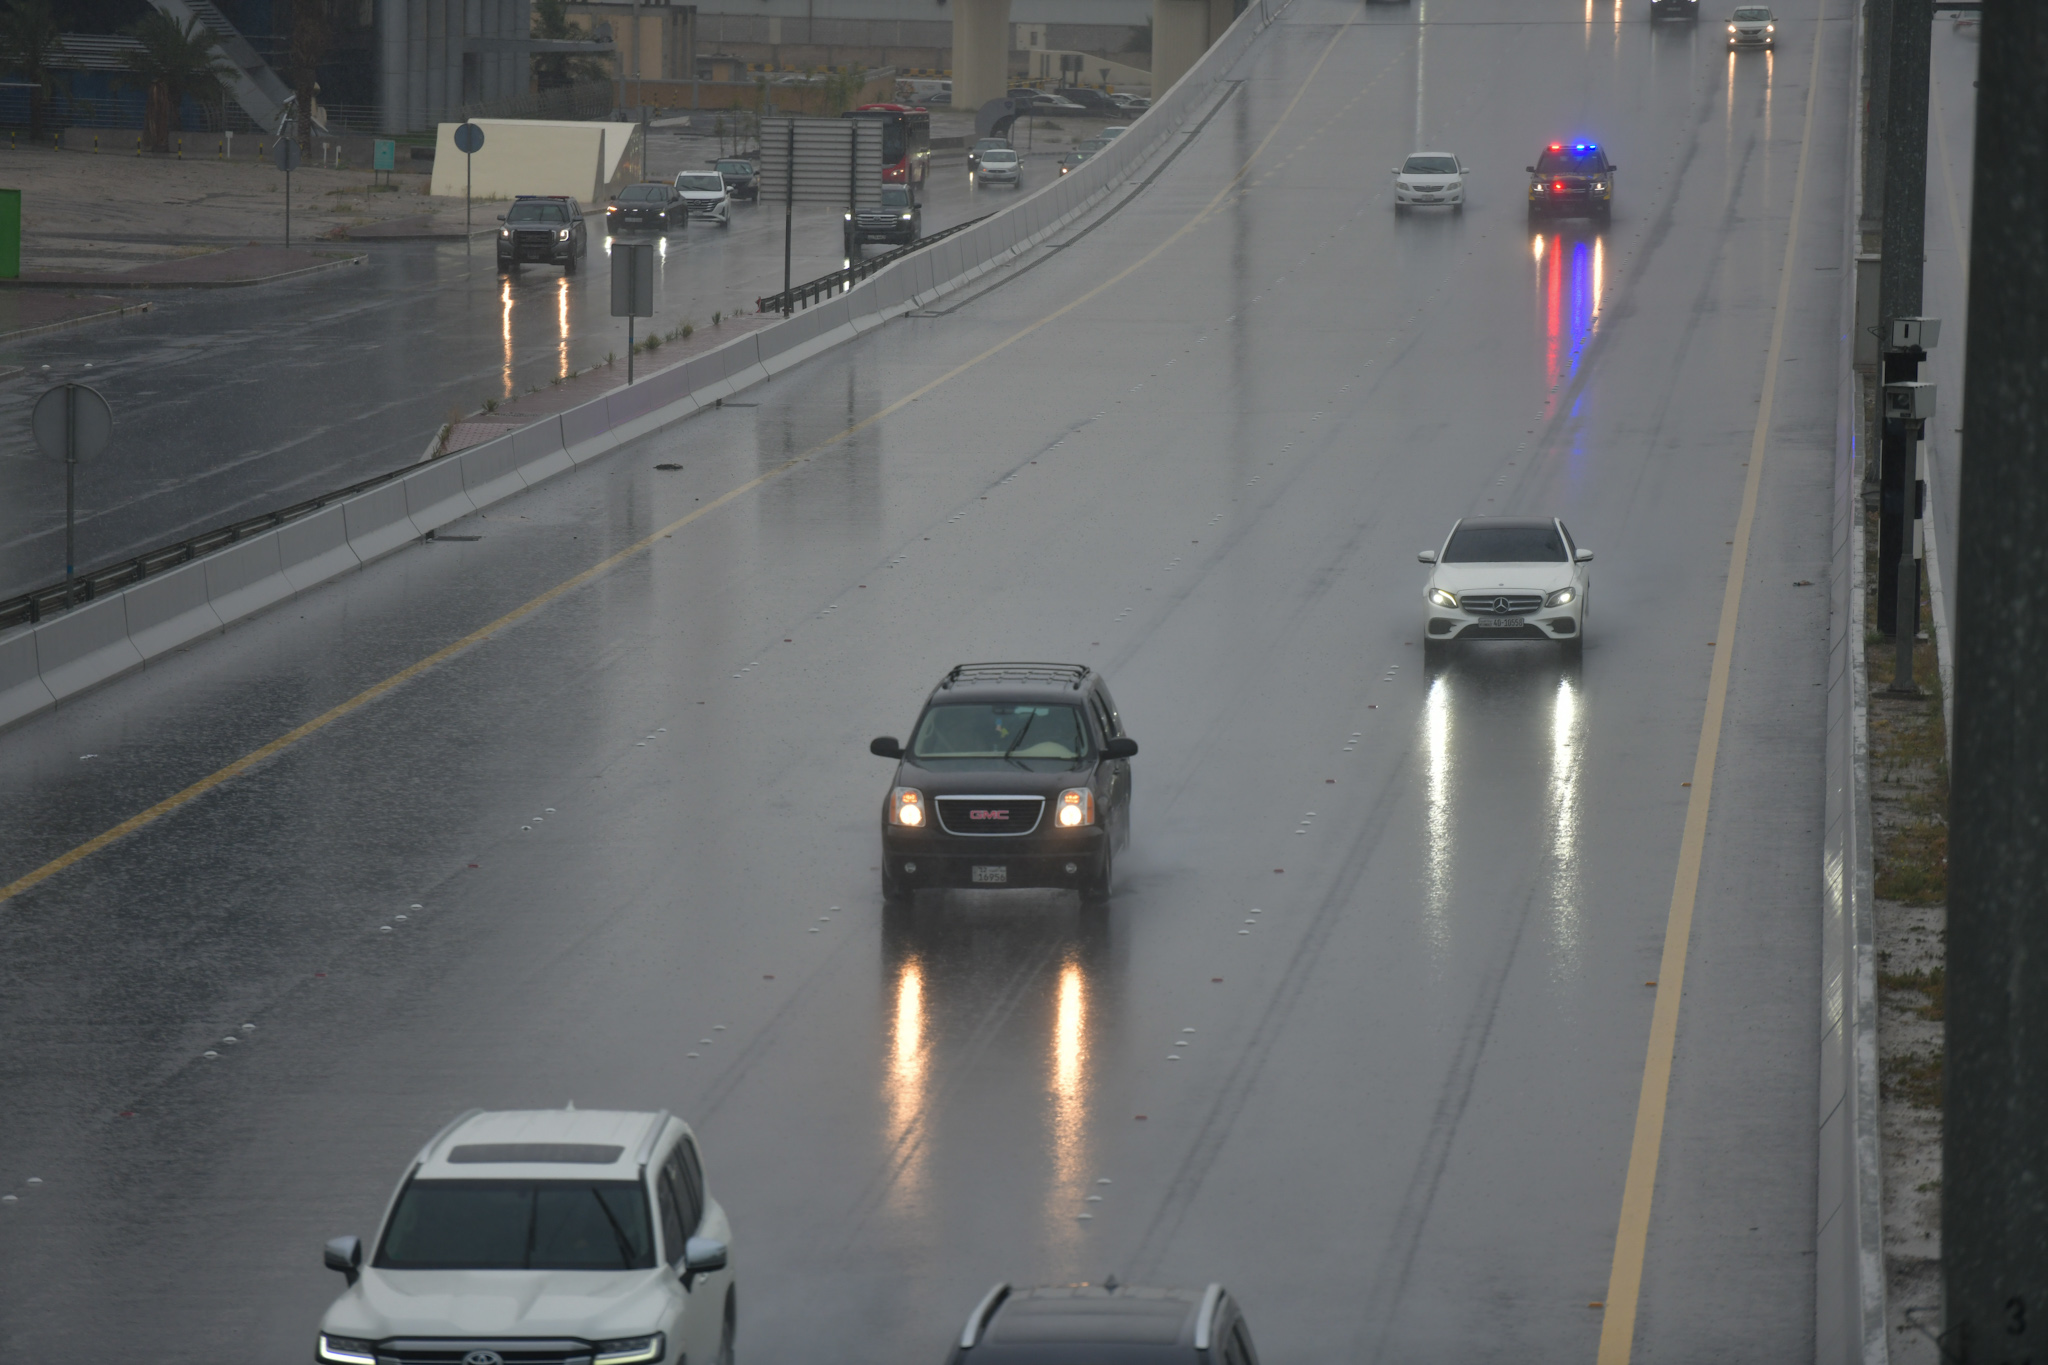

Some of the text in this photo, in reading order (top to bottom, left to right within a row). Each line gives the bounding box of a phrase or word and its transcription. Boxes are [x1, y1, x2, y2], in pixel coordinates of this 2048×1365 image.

[969, 809, 1010, 820] GMC
[978, 873, 1006, 882] 16956
[2003, 1295, 2027, 1336] 3
